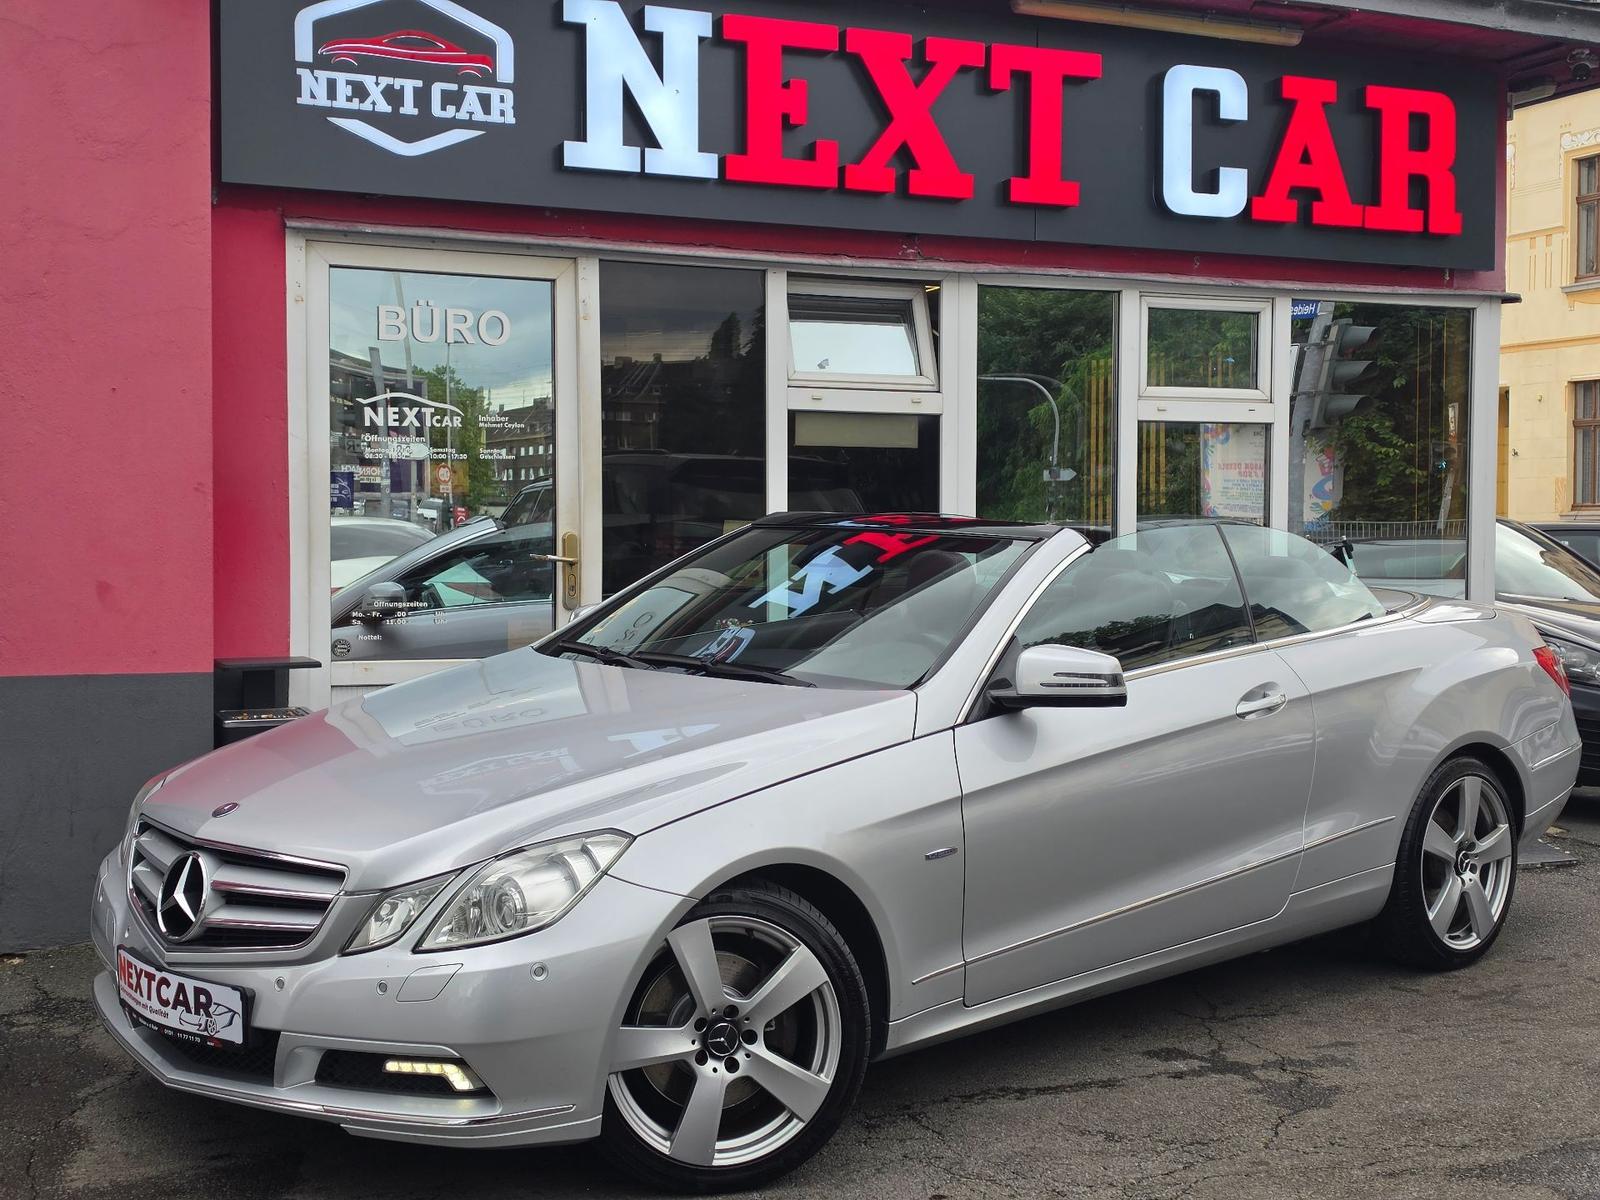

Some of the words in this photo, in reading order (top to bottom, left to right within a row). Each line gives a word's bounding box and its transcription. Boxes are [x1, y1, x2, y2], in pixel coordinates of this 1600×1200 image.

[296, 68, 422, 116] NEXT
[431, 82, 516, 125] CAR
[562, 0, 1103, 207] NEXT
[1162, 63, 1464, 236] CAR
[377, 299, 512, 347] BÜRO
[364, 432, 426, 443] Öffnungszeiten
[478, 414, 509, 422] Inhaber
[373, 600, 428, 609] Öffnungszeiten
[119, 953, 213, 1018] NEXTCAR
